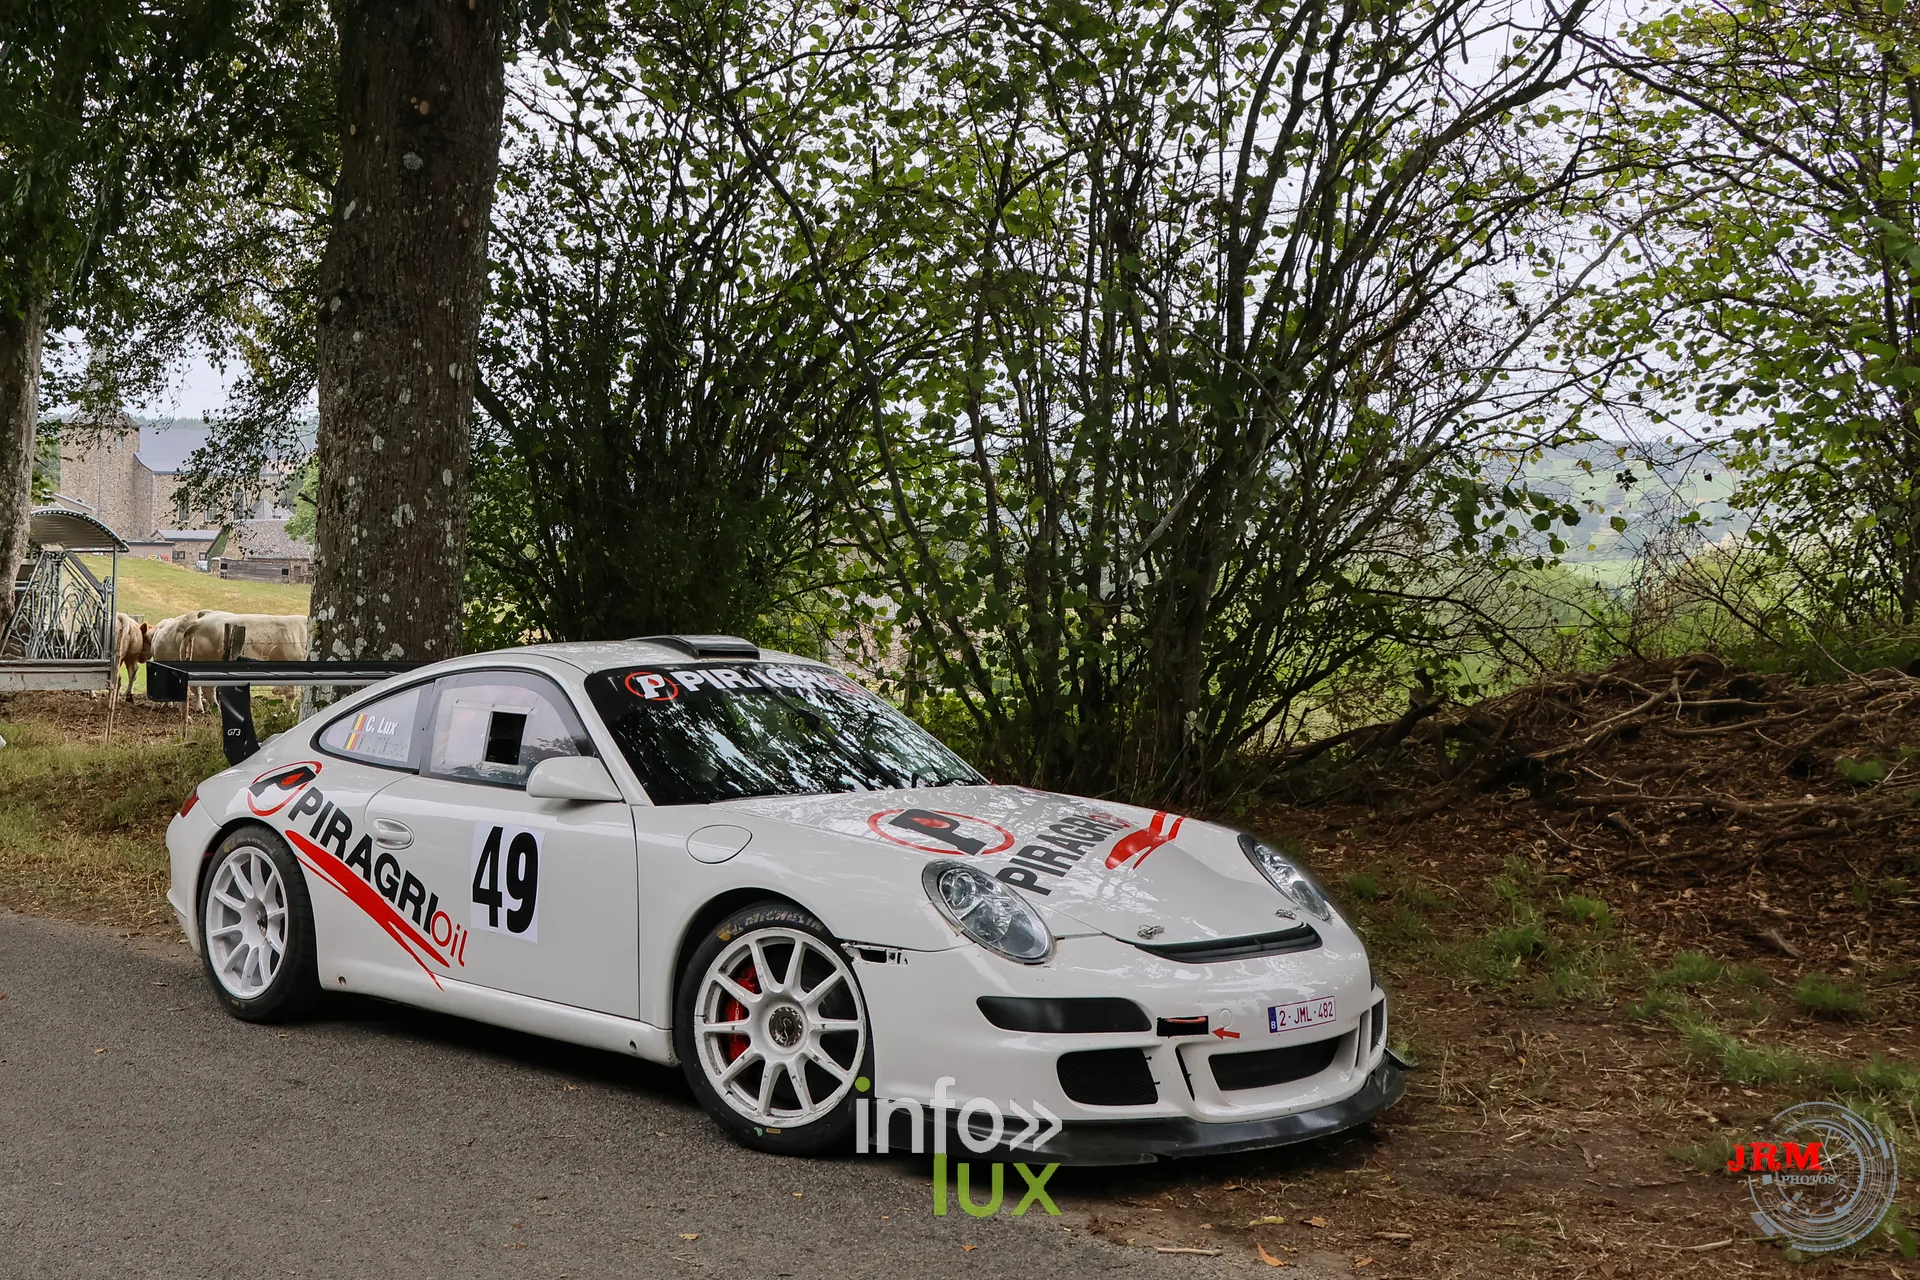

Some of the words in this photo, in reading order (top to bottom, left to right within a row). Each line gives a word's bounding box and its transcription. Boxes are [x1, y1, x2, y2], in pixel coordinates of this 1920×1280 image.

[227, 728, 242, 737] GT3
[377, 717, 398, 735] Lux
[472, 826, 539, 933] 49
[1271, 1021, 1276, 1029] B
